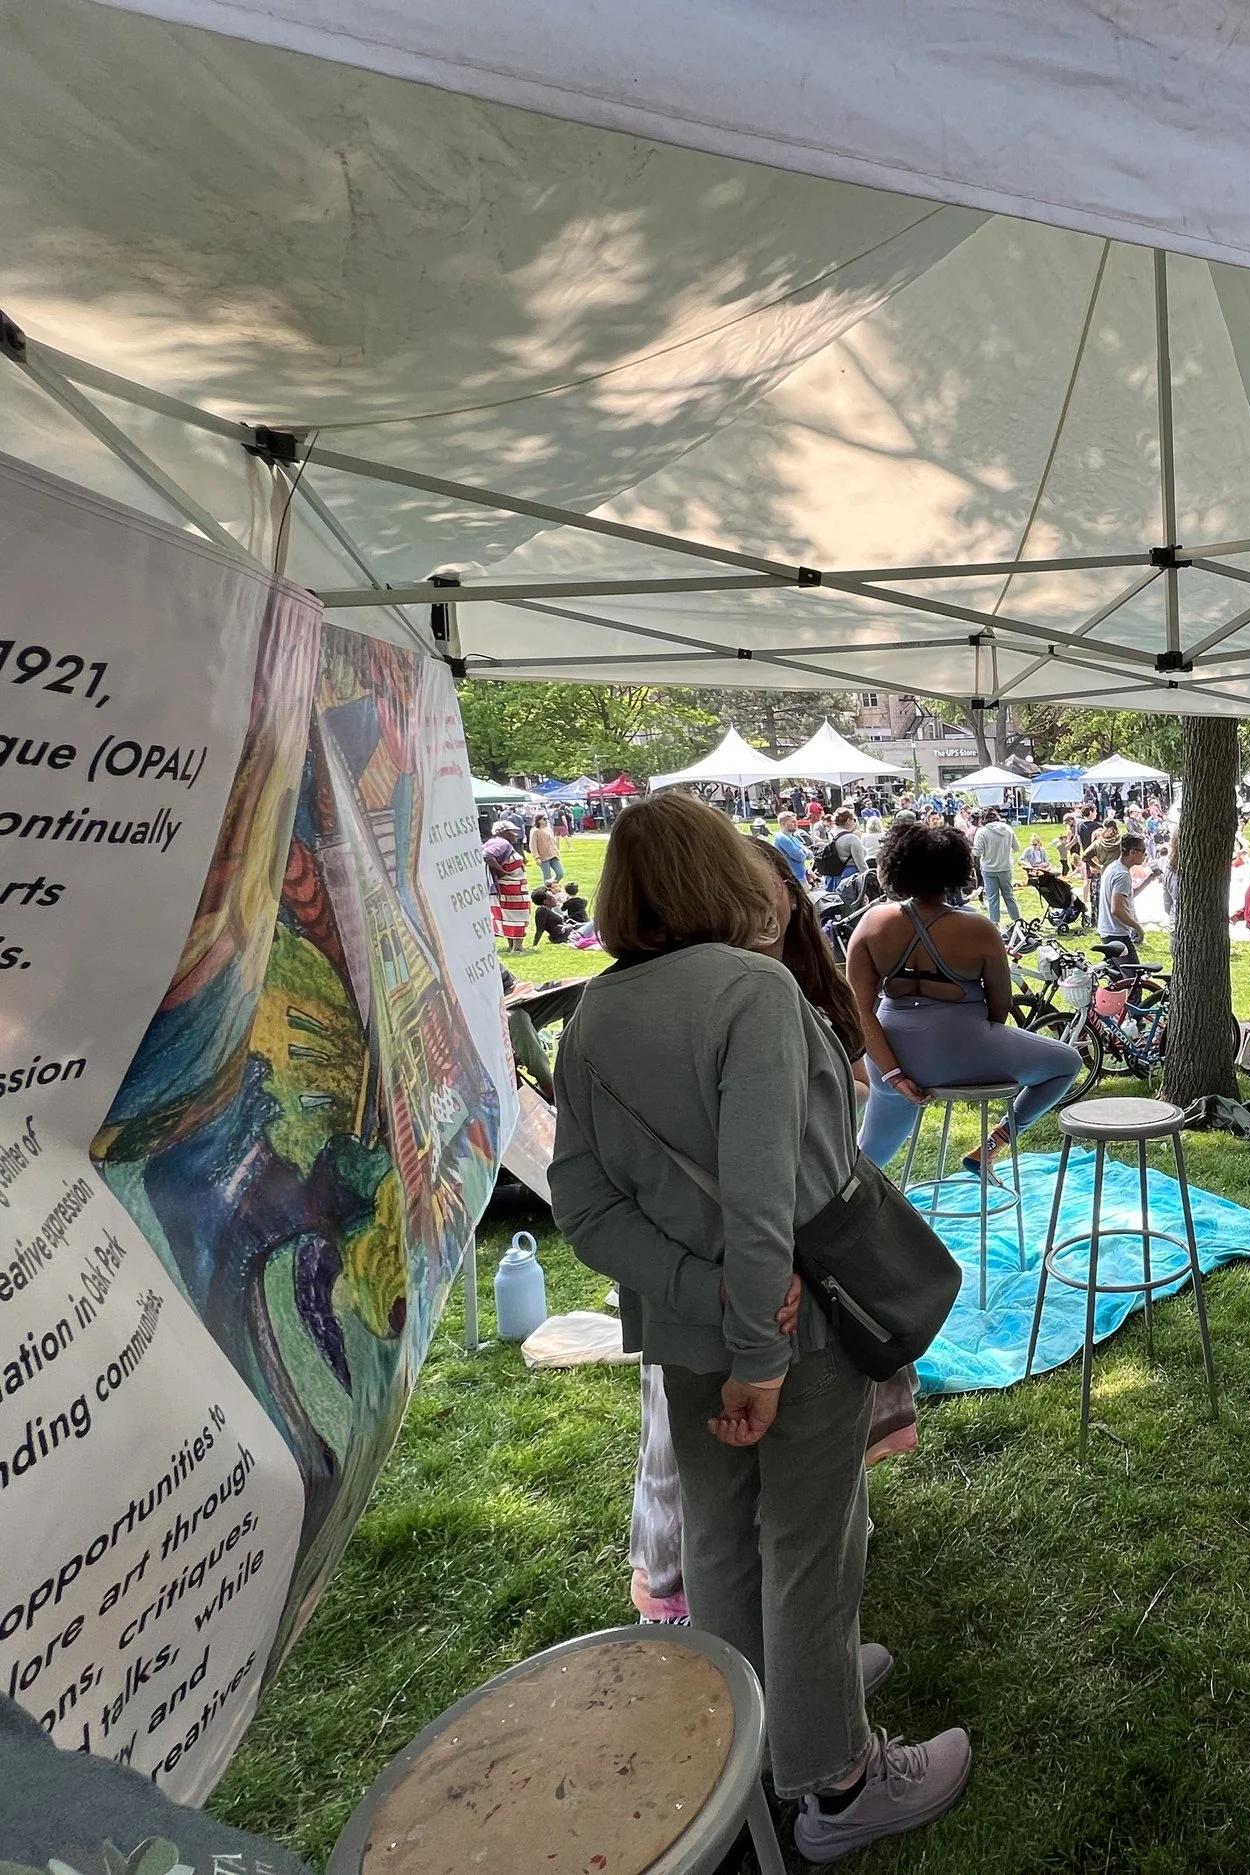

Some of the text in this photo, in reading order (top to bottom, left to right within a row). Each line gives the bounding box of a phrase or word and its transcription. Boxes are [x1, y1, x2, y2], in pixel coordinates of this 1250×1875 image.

[87, 734, 208, 789] (OPAL)
[946, 749, 959, 757] UPS
[959, 749, 977, 757] Store
[429, 824, 443, 846] ART
[22, 1115, 43, 1156] of
[41, 1178, 95, 1248] expression
[0, 1228, 127, 1398] ation in Oak Park
[95, 1288, 164, 1402] communities.
[0, 1404, 226, 1641] opportunities to
[99, 1549, 150, 1616] art
[161, 1442, 256, 1561] through
[119, 1511, 259, 1650] critiques,
[101, 1549, 264, 1737] talks, while
[147, 1644, 210, 1734] and
